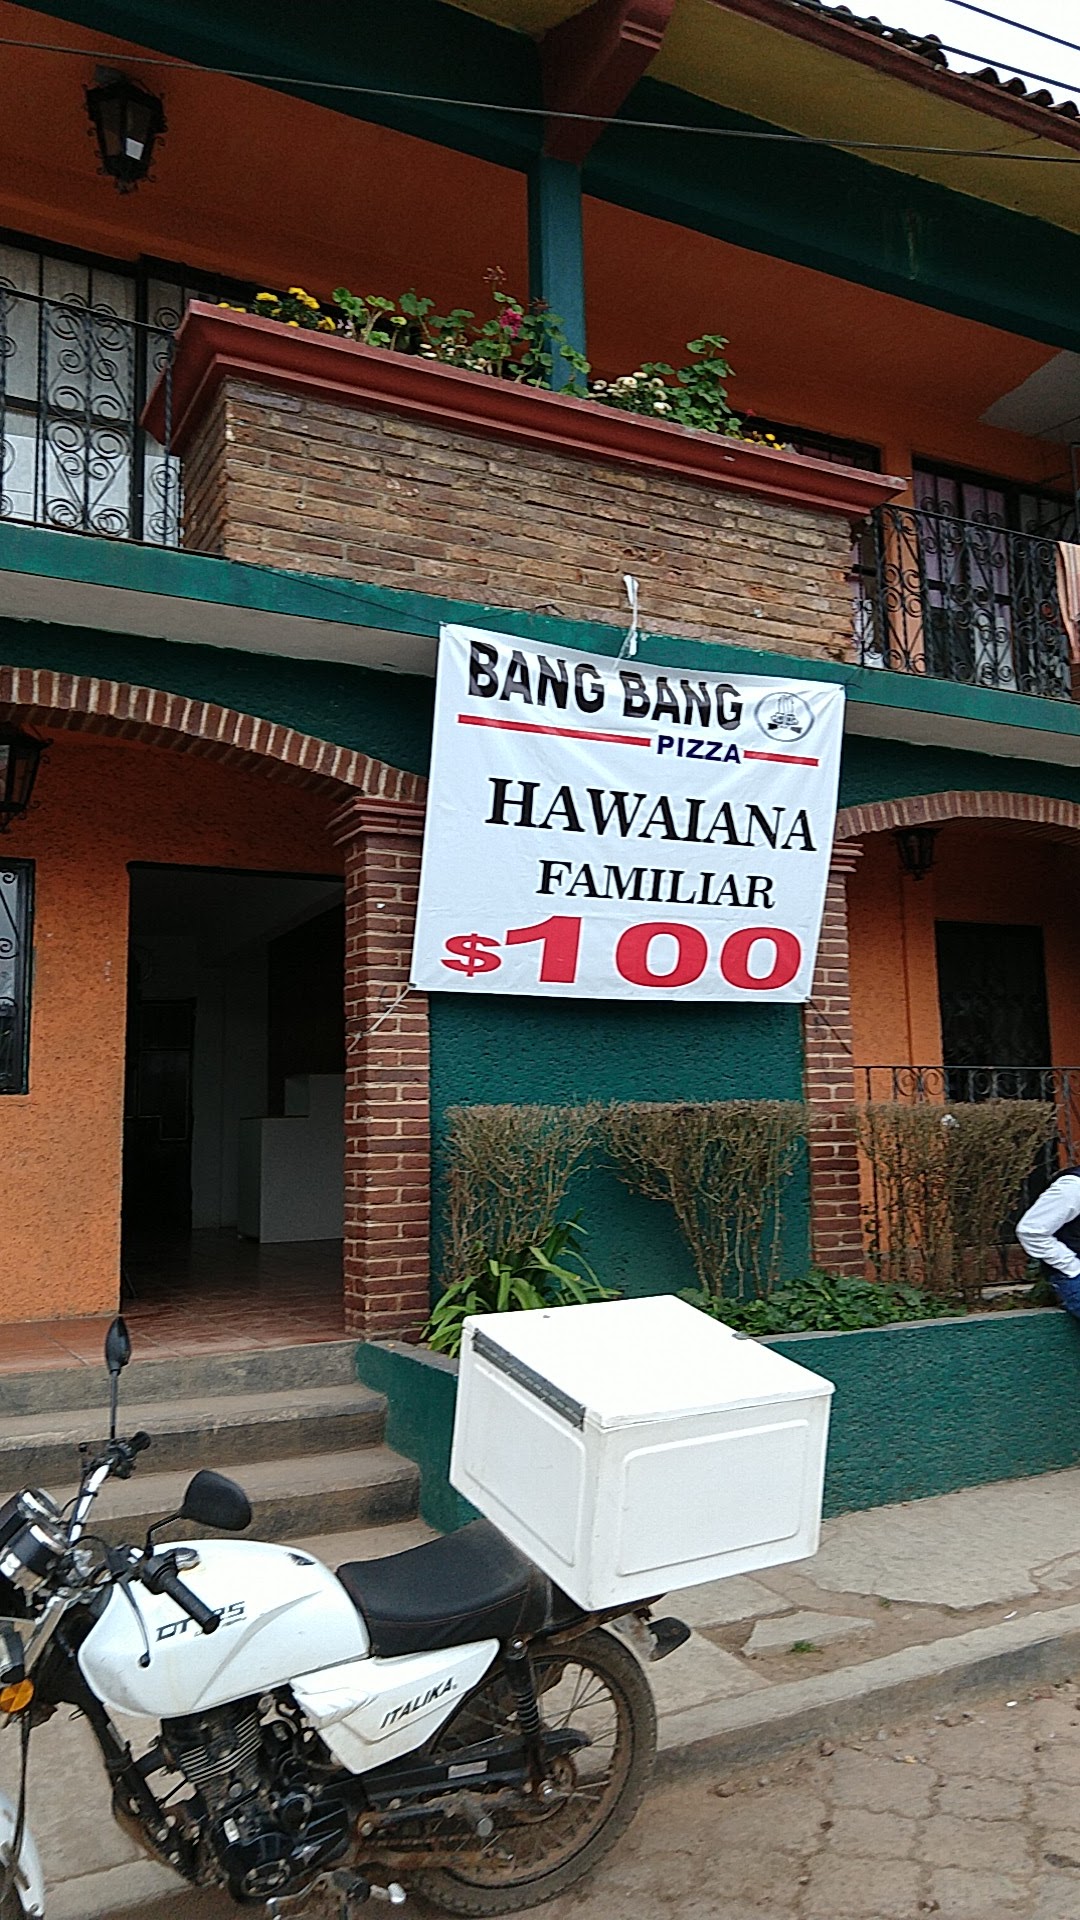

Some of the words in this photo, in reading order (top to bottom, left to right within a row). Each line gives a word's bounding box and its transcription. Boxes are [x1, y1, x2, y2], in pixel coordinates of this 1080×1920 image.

[468, 640, 605, 714] BANG
[618, 670, 744, 731] BANG
[656, 735, 742, 765] PIZZA
[485, 777, 818, 852] HAWAIANA
[535, 859, 776, 910] FAMILIAR
[440, 915, 802, 990] $100
[379, 1677, 454, 1730] ITALIKA
